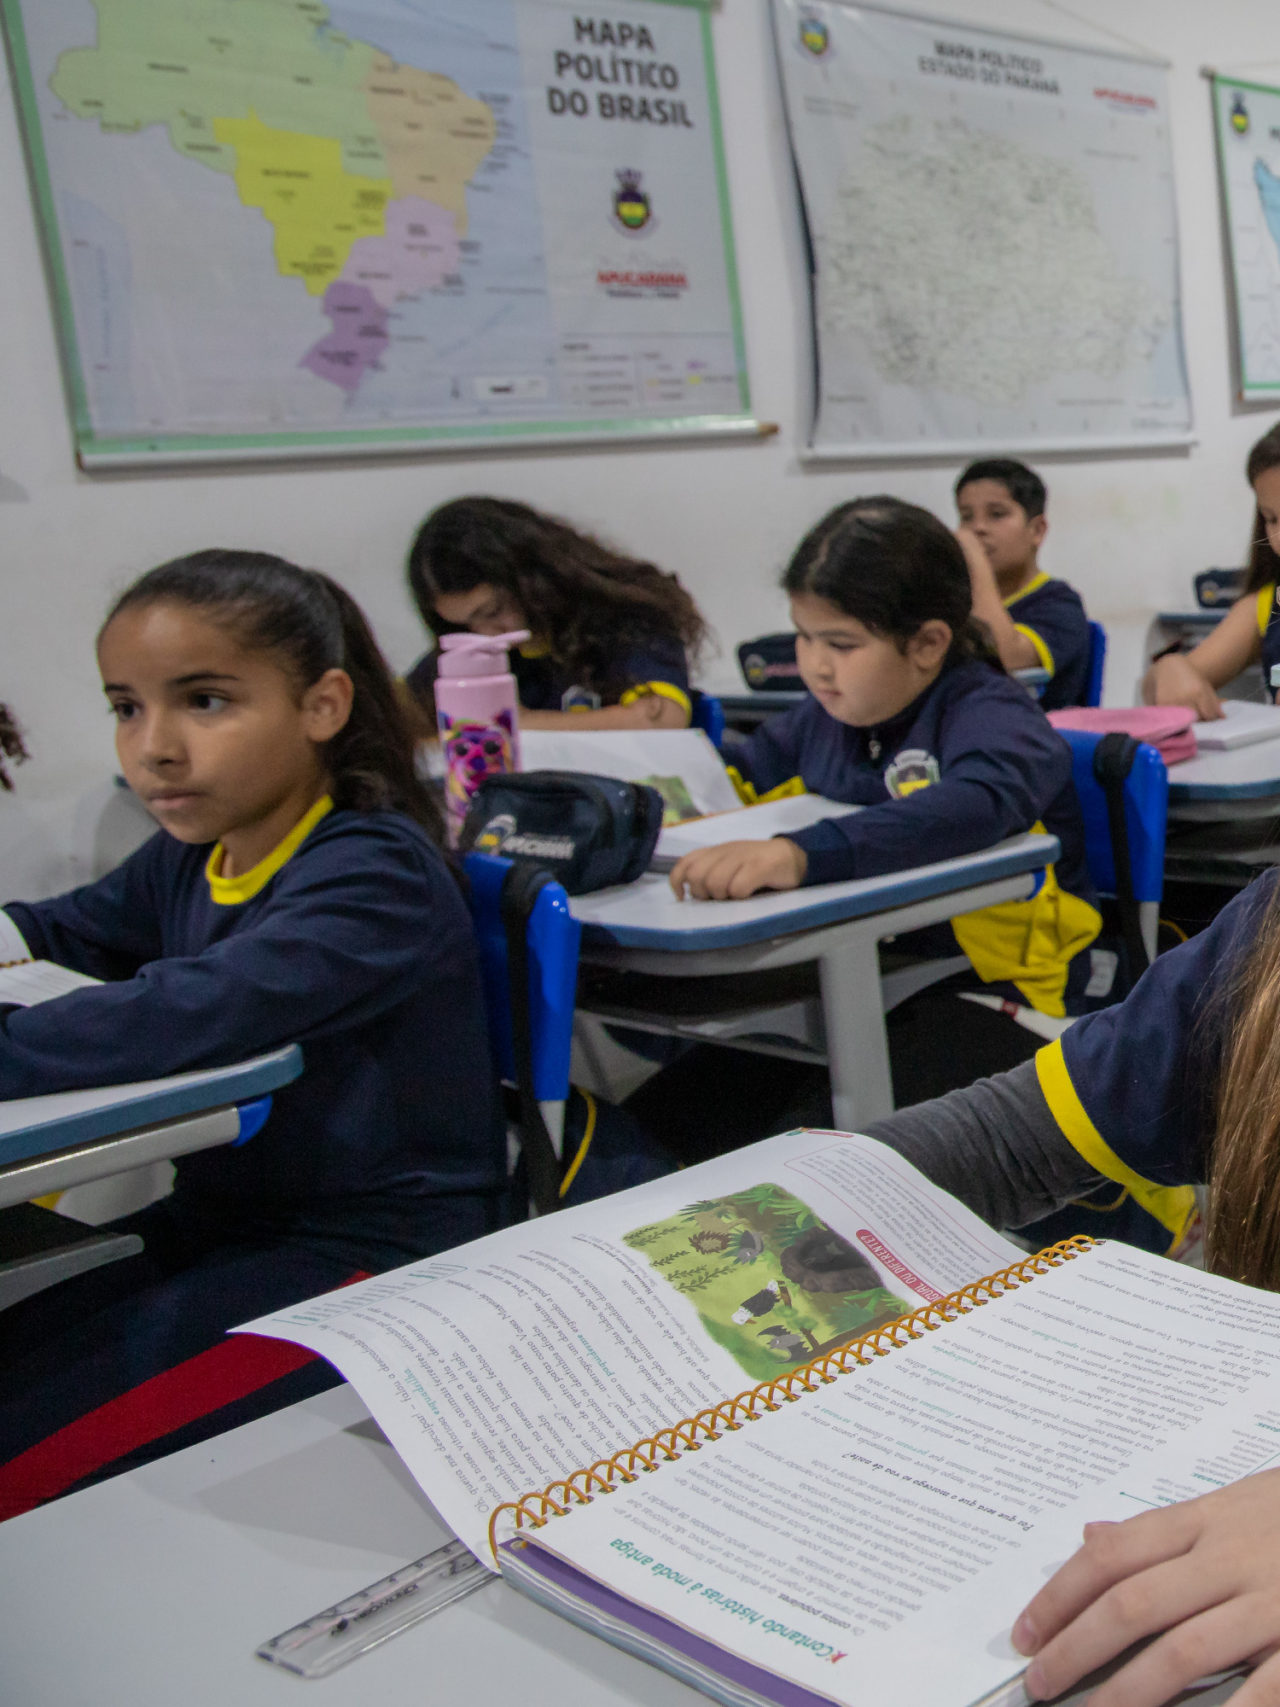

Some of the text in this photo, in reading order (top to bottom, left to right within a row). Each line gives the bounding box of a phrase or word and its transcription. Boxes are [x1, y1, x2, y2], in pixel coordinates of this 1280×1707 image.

[574, 16, 655, 50] MAPA
[555, 50, 679, 91] POLÍTICO
[548, 86, 694, 129] DO BRASIL
[860, 1235, 904, 1273] DIFERENTE?
[899, 1272, 916, 1283] OU
[550, 1303, 578, 1332] erguendo
[644, 1305, 656, 1319] voa
[612, 1331, 625, 1345] dois
[527, 1341, 544, 1360] como
[577, 1334, 614, 1376] paquiderme
[623, 1346, 642, 1363] pelos
[443, 1365, 458, 1383] luta
[475, 1354, 496, 1379] fechou
[521, 1361, 533, 1375] um
[542, 1361, 563, 1382] patas
[695, 1368, 710, 1380] que
[393, 1380, 411, 1402] falou
[475, 1384, 499, 1411] quanto
[531, 1376, 552, 1400] rosnou
[559, 1383, 581, 1408] quatro
[615, 1383, 635, 1407] berrou
[440, 1387, 464, 1417] animais
[495, 1413, 512, 1432] tudo
[510, 1401, 533, 1429] mesma
[438, 1416, 463, 1449] vitoriosa
[587, 1420, 606, 1441] bicho
[511, 1432, 530, 1451] para
[444, 1454, 457, 1467] me
[463, 1452, 481, 1473] nossa
[525, 1453, 548, 1474] penas
[455, 1469, 478, 1494] queira
[912, 1479, 949, 1496] morcego
[997, 1513, 1016, 1521] que
[1017, 1520, 1034, 1531] Por
[610, 1538, 832, 1656] Contando histórias à moda antiga
